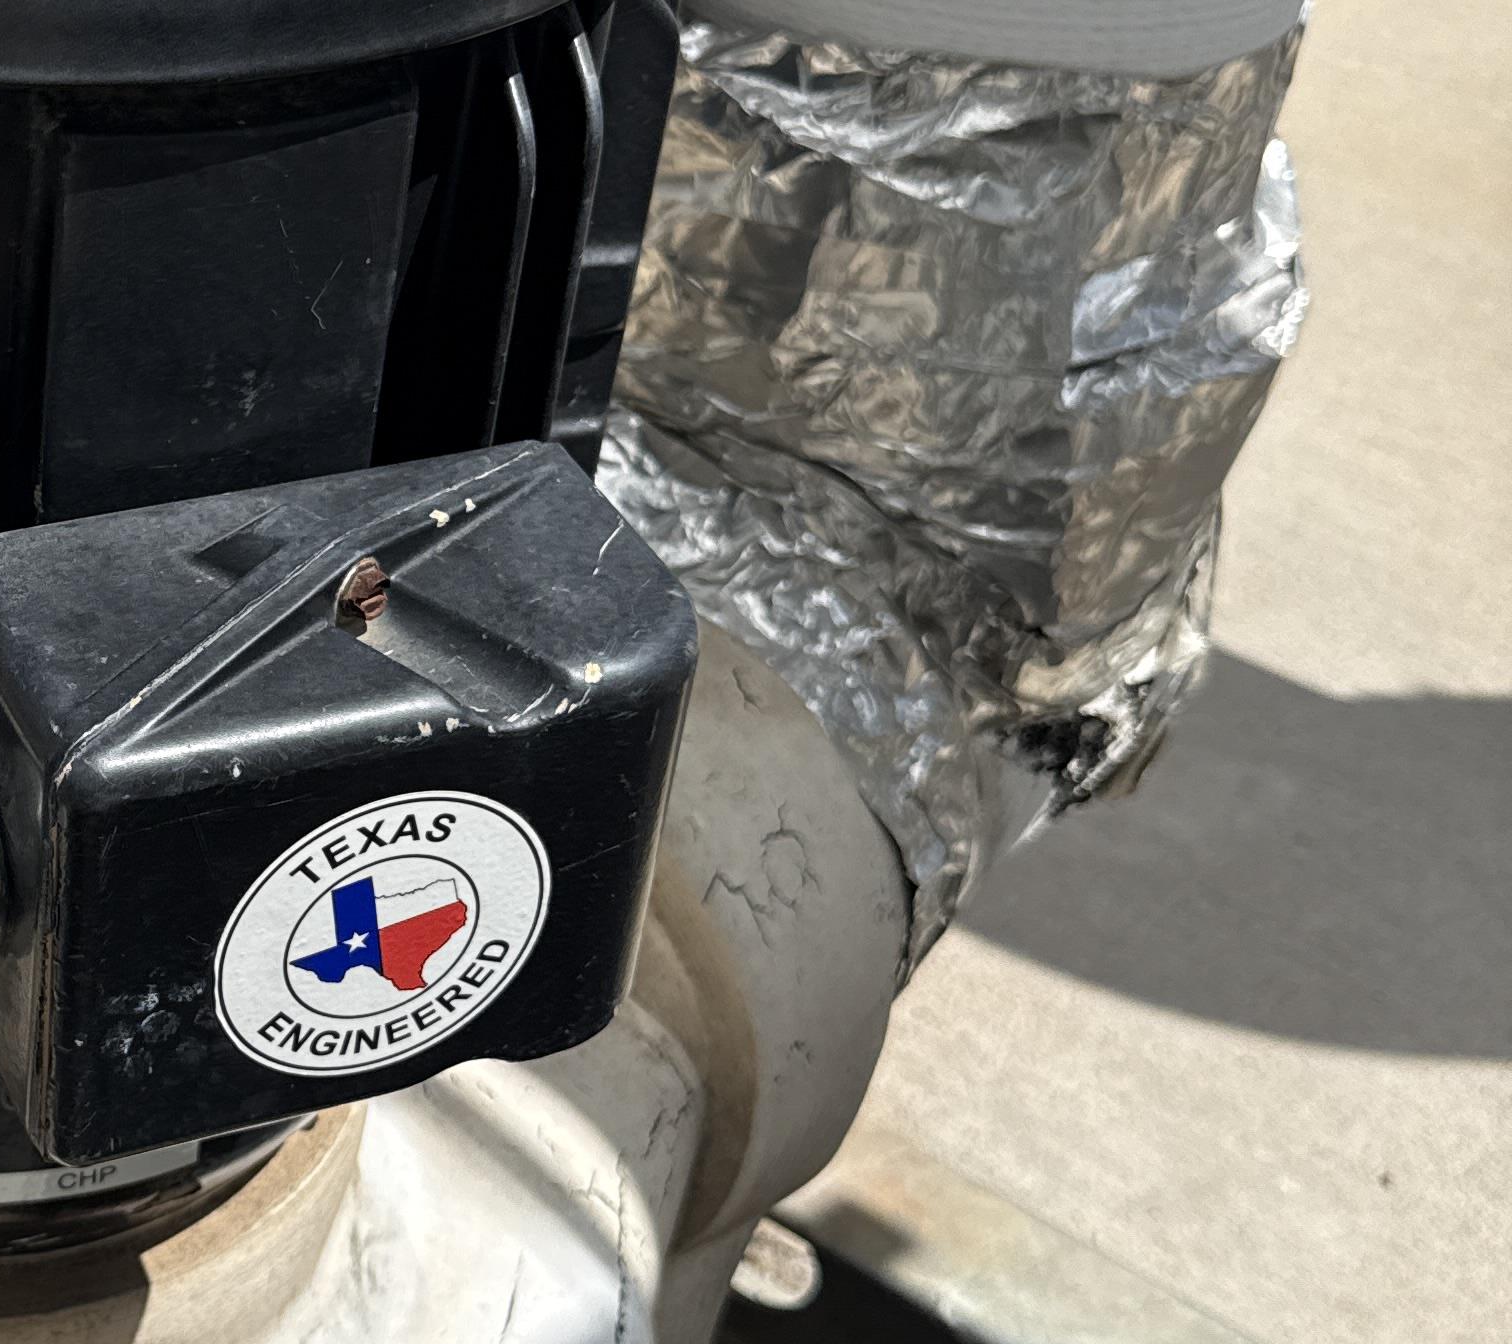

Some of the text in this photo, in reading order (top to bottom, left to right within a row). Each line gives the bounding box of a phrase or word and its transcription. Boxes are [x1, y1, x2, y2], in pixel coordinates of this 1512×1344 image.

[289, 812, 457, 885] TEXAS
[256, 938, 510, 1056] ENGINEERED
[57, 1164, 117, 1190] CHP
